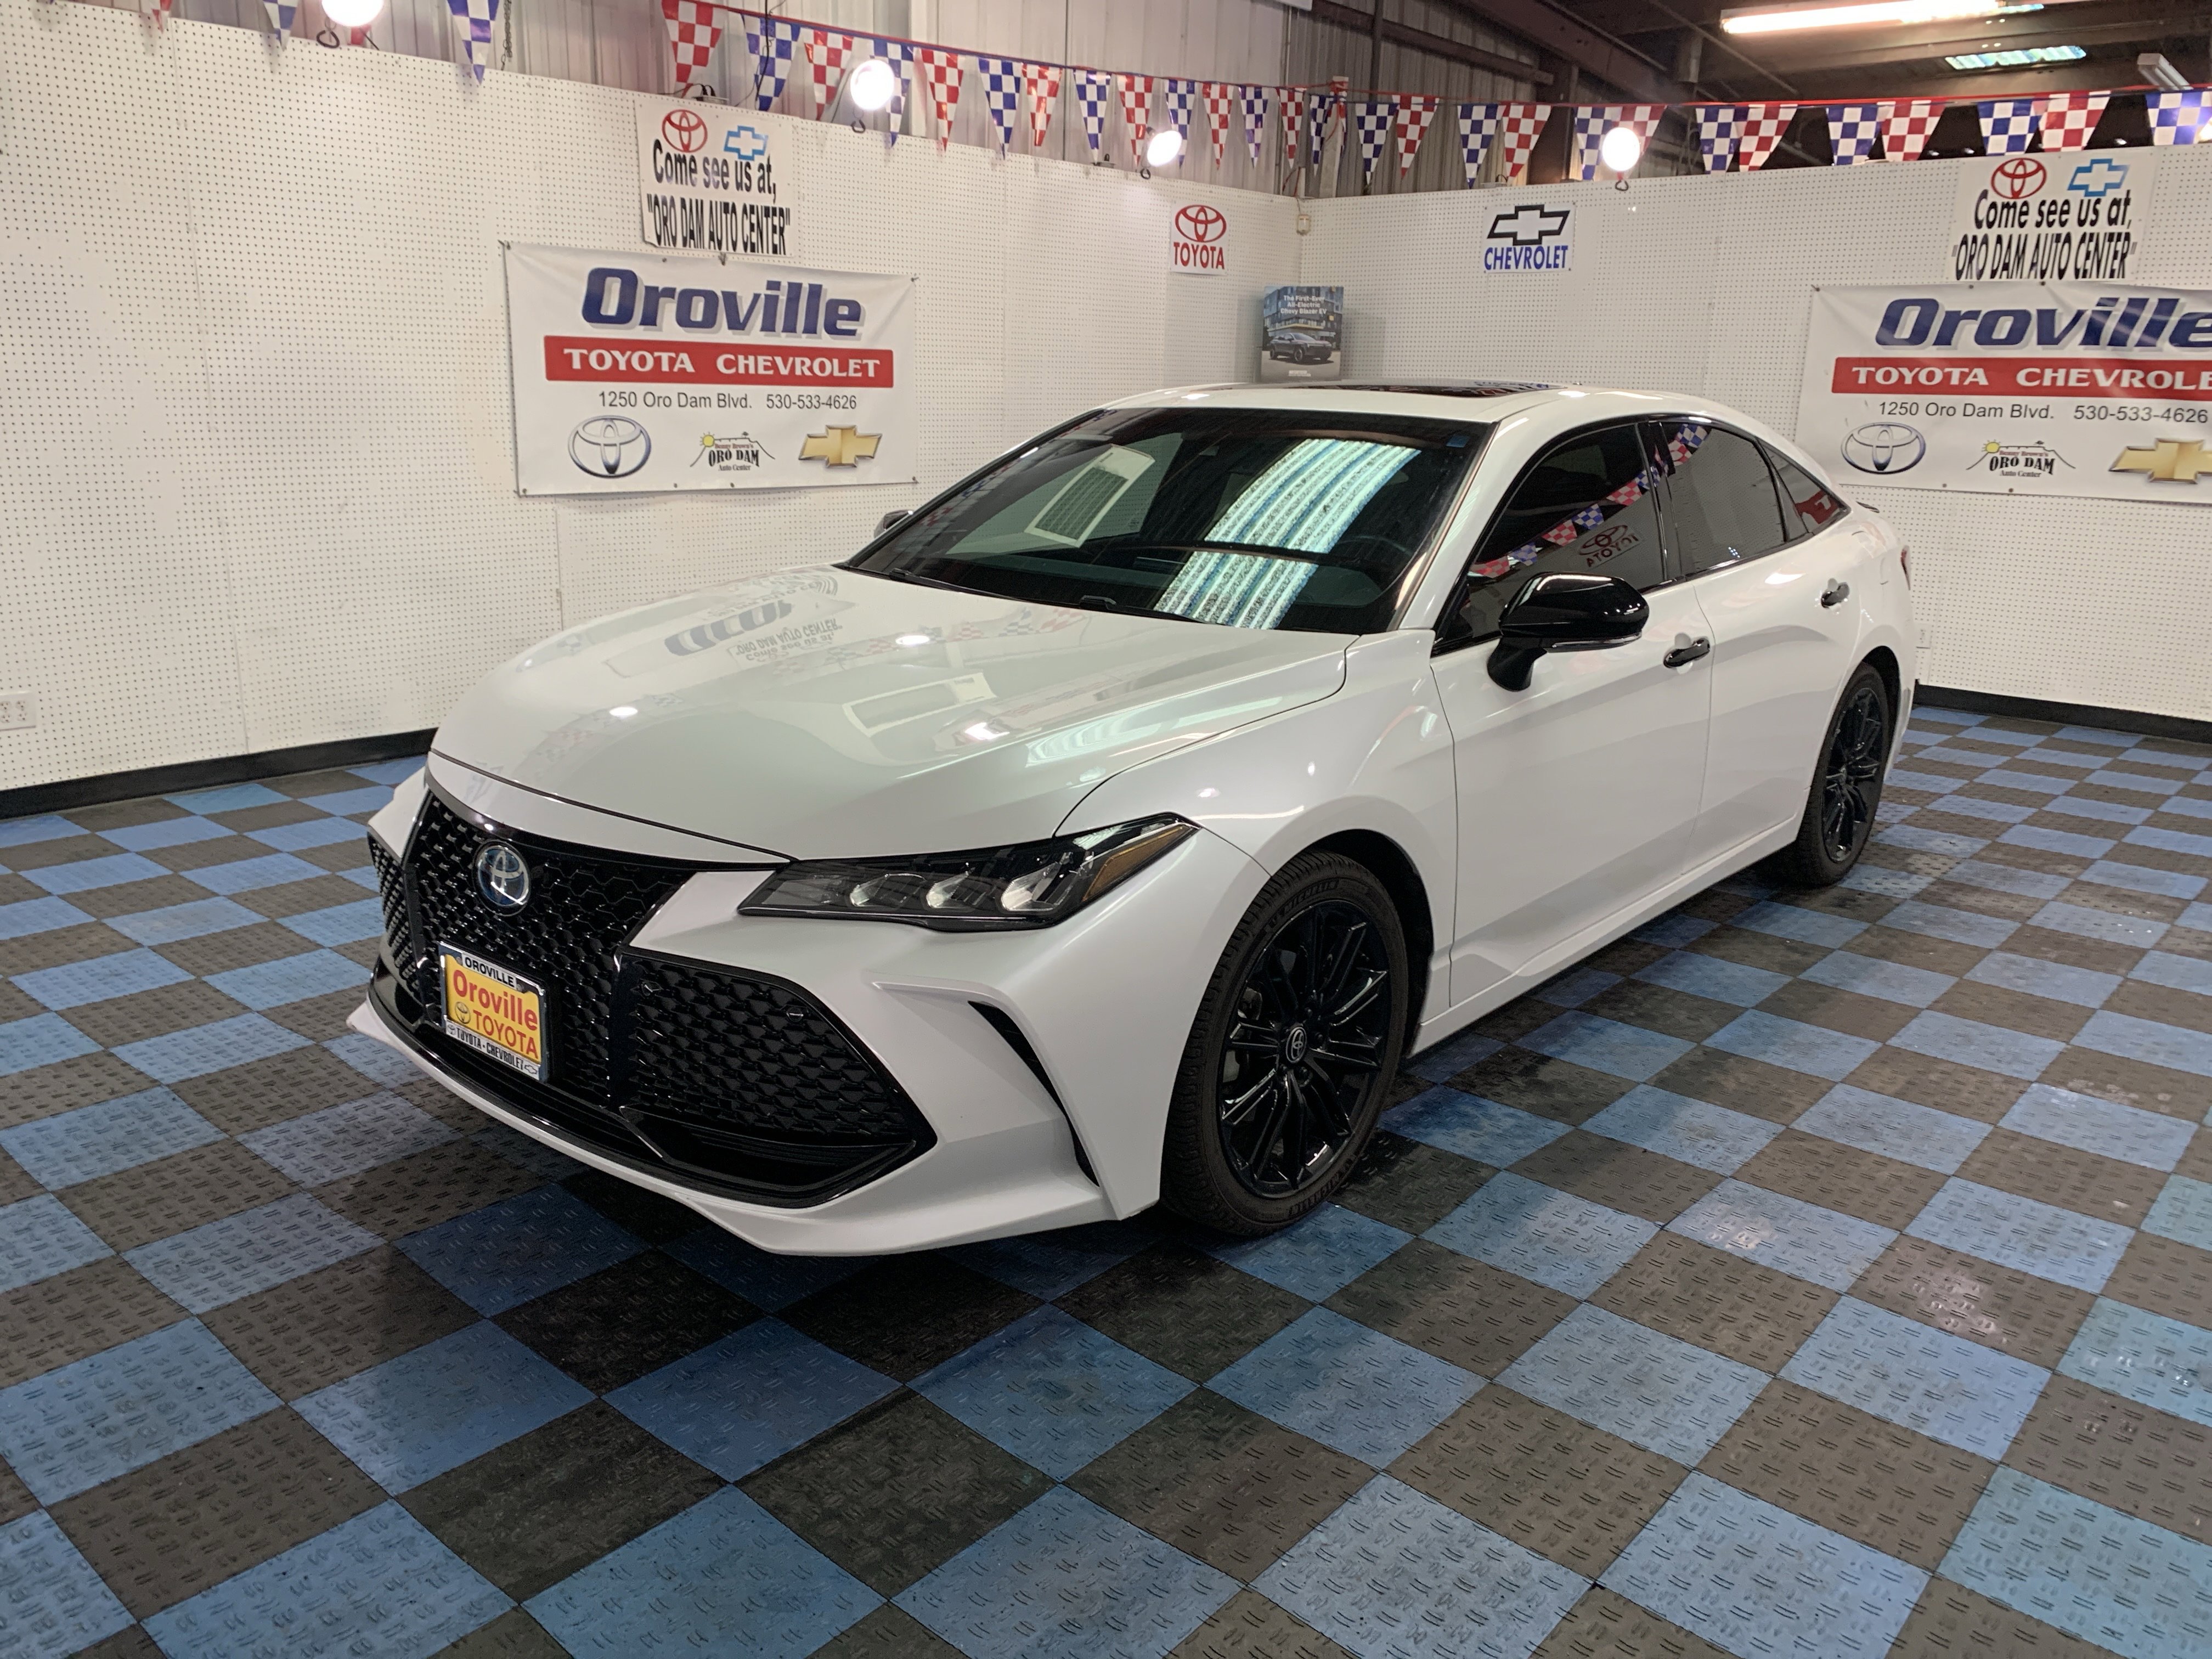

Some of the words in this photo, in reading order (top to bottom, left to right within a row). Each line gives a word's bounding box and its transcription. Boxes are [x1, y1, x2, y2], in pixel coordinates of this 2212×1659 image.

[653, 138, 698, 187] Come
[703, 156, 730, 190] see
[735, 161, 752, 192] us
[757, 154, 776, 204] at,
[681, 197, 704, 249] DAM
[708, 200, 738, 252] AUTO
[1974, 189, 2029, 229] Come
[2036, 199, 2070, 228] see
[2078, 198, 2102, 227] us
[2107, 189, 2132, 229] at,
[1173, 242, 1225, 269] TOYOTA
[1484, 245, 1568, 270] CHEVROLET
[1990, 234, 2028, 279] DAM
[2029, 232, 2072, 280] AUTO
[582, 267, 864, 337] Oroville
[1875, 297, 2212, 351] Oroville
[563, 348, 695, 373] TOYOTA
[716, 354, 881, 378] CHEVROLET
[1852, 367, 1989, 385] TOYOTA
[2016, 368, 2212, 390] CHEVROLE
[599, 391, 637, 407] 1250
[643, 392, 673, 409] Oro
[678, 393, 712, 410] Dam
[717, 393, 752, 410] Blvd.
[766, 393, 857, 410] 530-533-4626
[1879, 402, 1919, 416] 1250
[1925, 403, 1956, 417] Oro
[1962, 403, 2003, 418] Dam
[2010, 404, 2055, 419] Blvd.
[2074, 405, 2208, 423] 530-533-4626
[709, 450, 732, 467] ORO
[736, 450, 759, 467] DAM
[1989, 456, 2019, 471] ORO
[2024, 458, 2056, 475] DAM
[464, 957, 515, 987] OROVILLE
[453, 969, 538, 1031] Oroville
[456, 1027, 482, 1050] TOYOTA
[487, 1042, 524, 1070] CHEVROLET
[473, 1009, 538, 1059] TOYOTA
